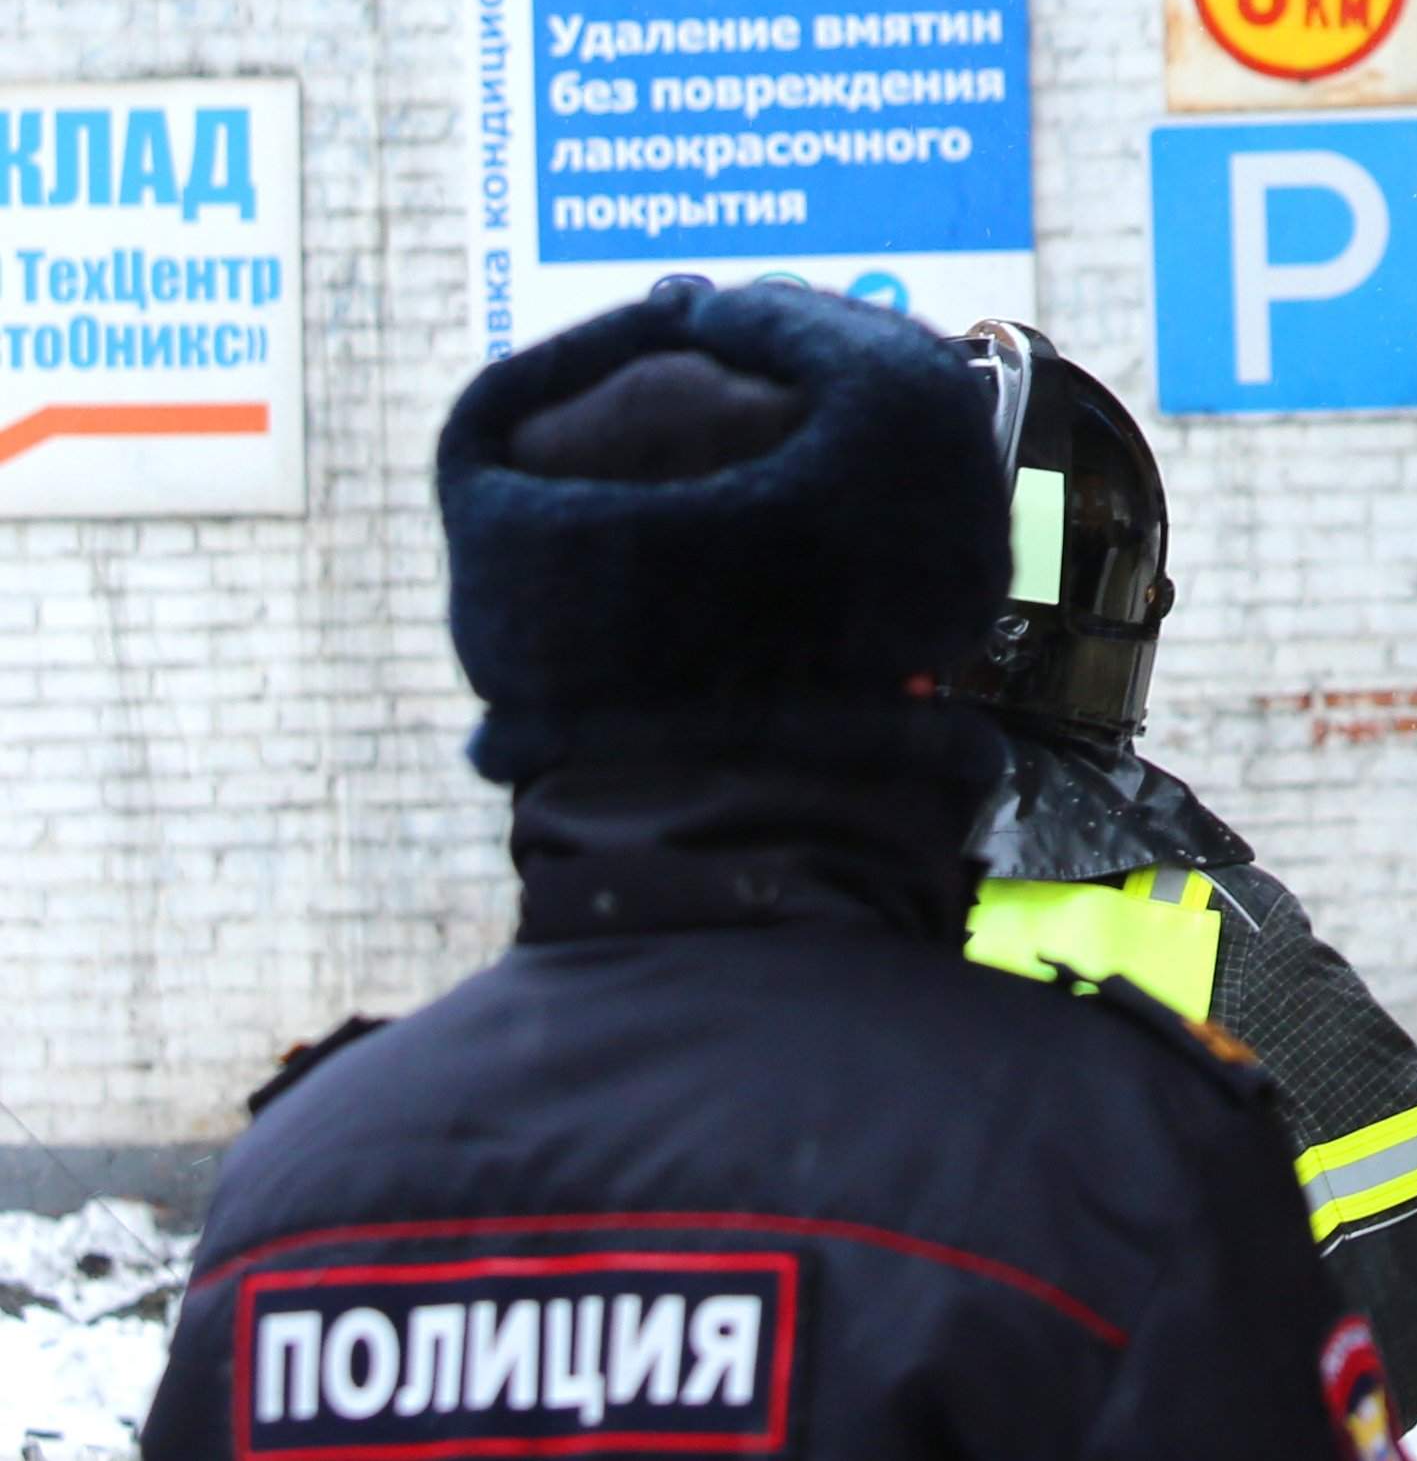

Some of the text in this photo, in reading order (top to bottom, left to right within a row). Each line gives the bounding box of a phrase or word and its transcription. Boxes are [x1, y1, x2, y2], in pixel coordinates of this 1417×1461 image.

[548, 11, 1003, 61] Удаление вмятин
[549, 68, 1005, 119] без повреждения
[550, 127, 972, 178] лакокрасочного
[553, 191, 807, 237] покрытия
[15, 249, 282, 311] ТехЦентр
[483, 248, 513, 361] авка
[0, 313, 268, 370] тоОникс»
[256, 1293, 763, 1426] ПОЛИЦИЯ
